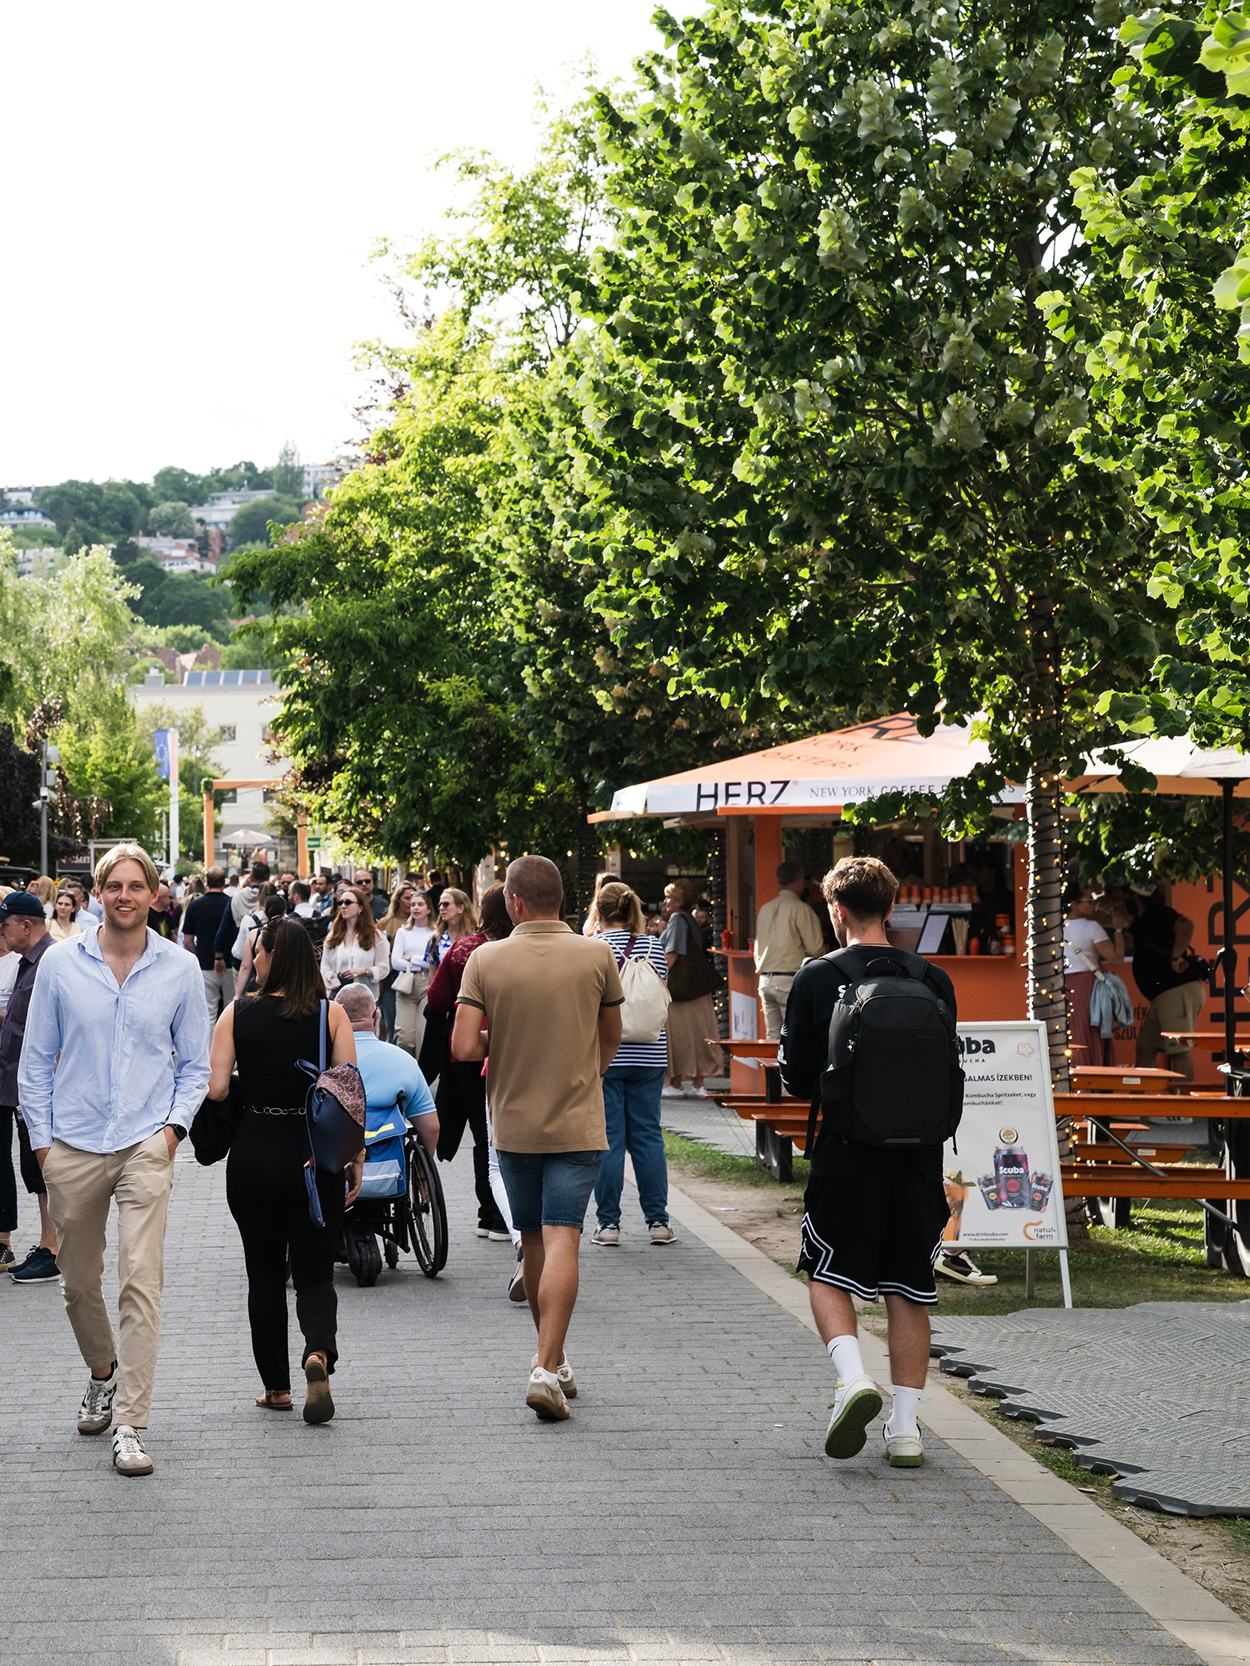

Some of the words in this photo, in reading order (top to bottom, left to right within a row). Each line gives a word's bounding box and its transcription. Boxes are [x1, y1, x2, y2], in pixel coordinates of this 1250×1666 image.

[696, 780, 791, 812] HERZ
[810, 786, 839, 799] NEW
[841, 785, 875, 798] YORK
[996, 1072, 1033, 1082] ÍZEKBEN!
[998, 1165, 1025, 1175] Scuba
